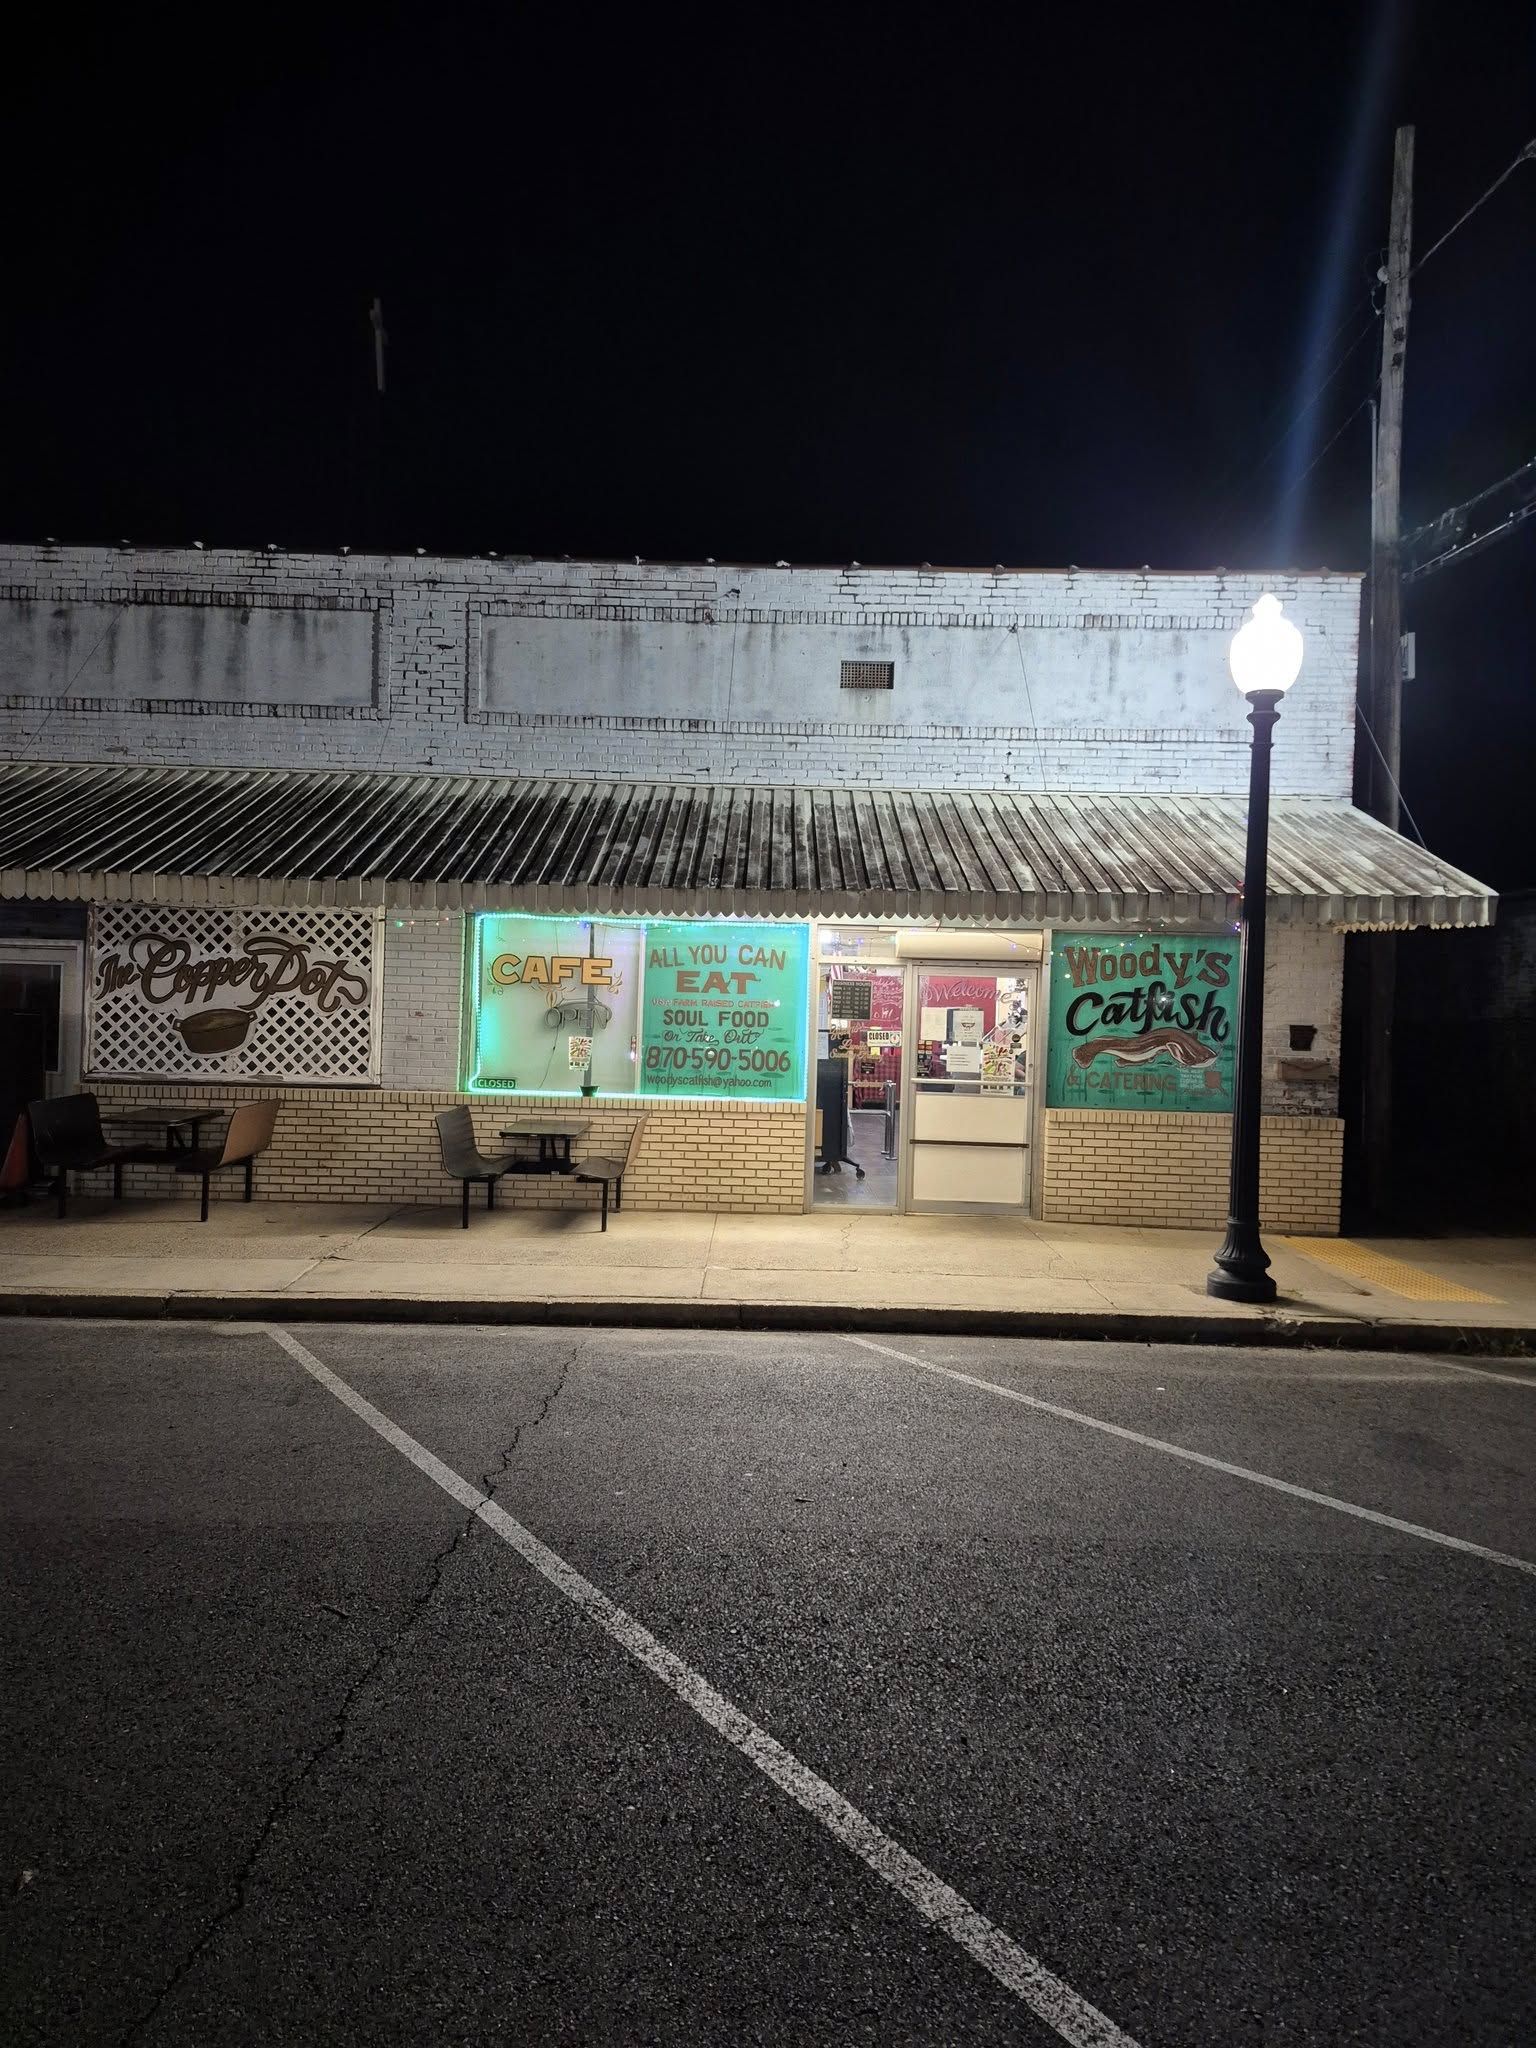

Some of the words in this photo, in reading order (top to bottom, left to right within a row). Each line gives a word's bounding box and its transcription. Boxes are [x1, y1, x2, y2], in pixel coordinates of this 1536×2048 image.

[96, 953, 141, 1000] The
[129, 933, 269, 1004] Copper
[649, 947, 684, 968] ALL
[688, 944, 727, 966] YOU
[738, 944, 786, 970] CAN
[1064, 943, 1232, 988] Woody's
[491, 953, 613, 986] CAFE
[677, 970, 761, 994] EAT
[922, 981, 1012, 1004] Welcome
[701, 999, 734, 1008] RAISED
[737, 1000, 776, 1009] CATFISH
[1066, 981, 1229, 1041] Catfish
[663, 1009, 709, 1026] SOUL
[718, 1010, 769, 1028] FOOD
[685, 1028, 719, 1046] Take
[724, 1028, 764, 1044] Out
[868, 1032, 889, 1041] CLOSED
[646, 1046, 791, 1072] 870-590-5006
[477, 1079, 515, 1089] CLOSED
[647, 1074, 772, 1089] woodyscatfish@yahoo.com
[1086, 1071, 1177, 1092] CATERING
